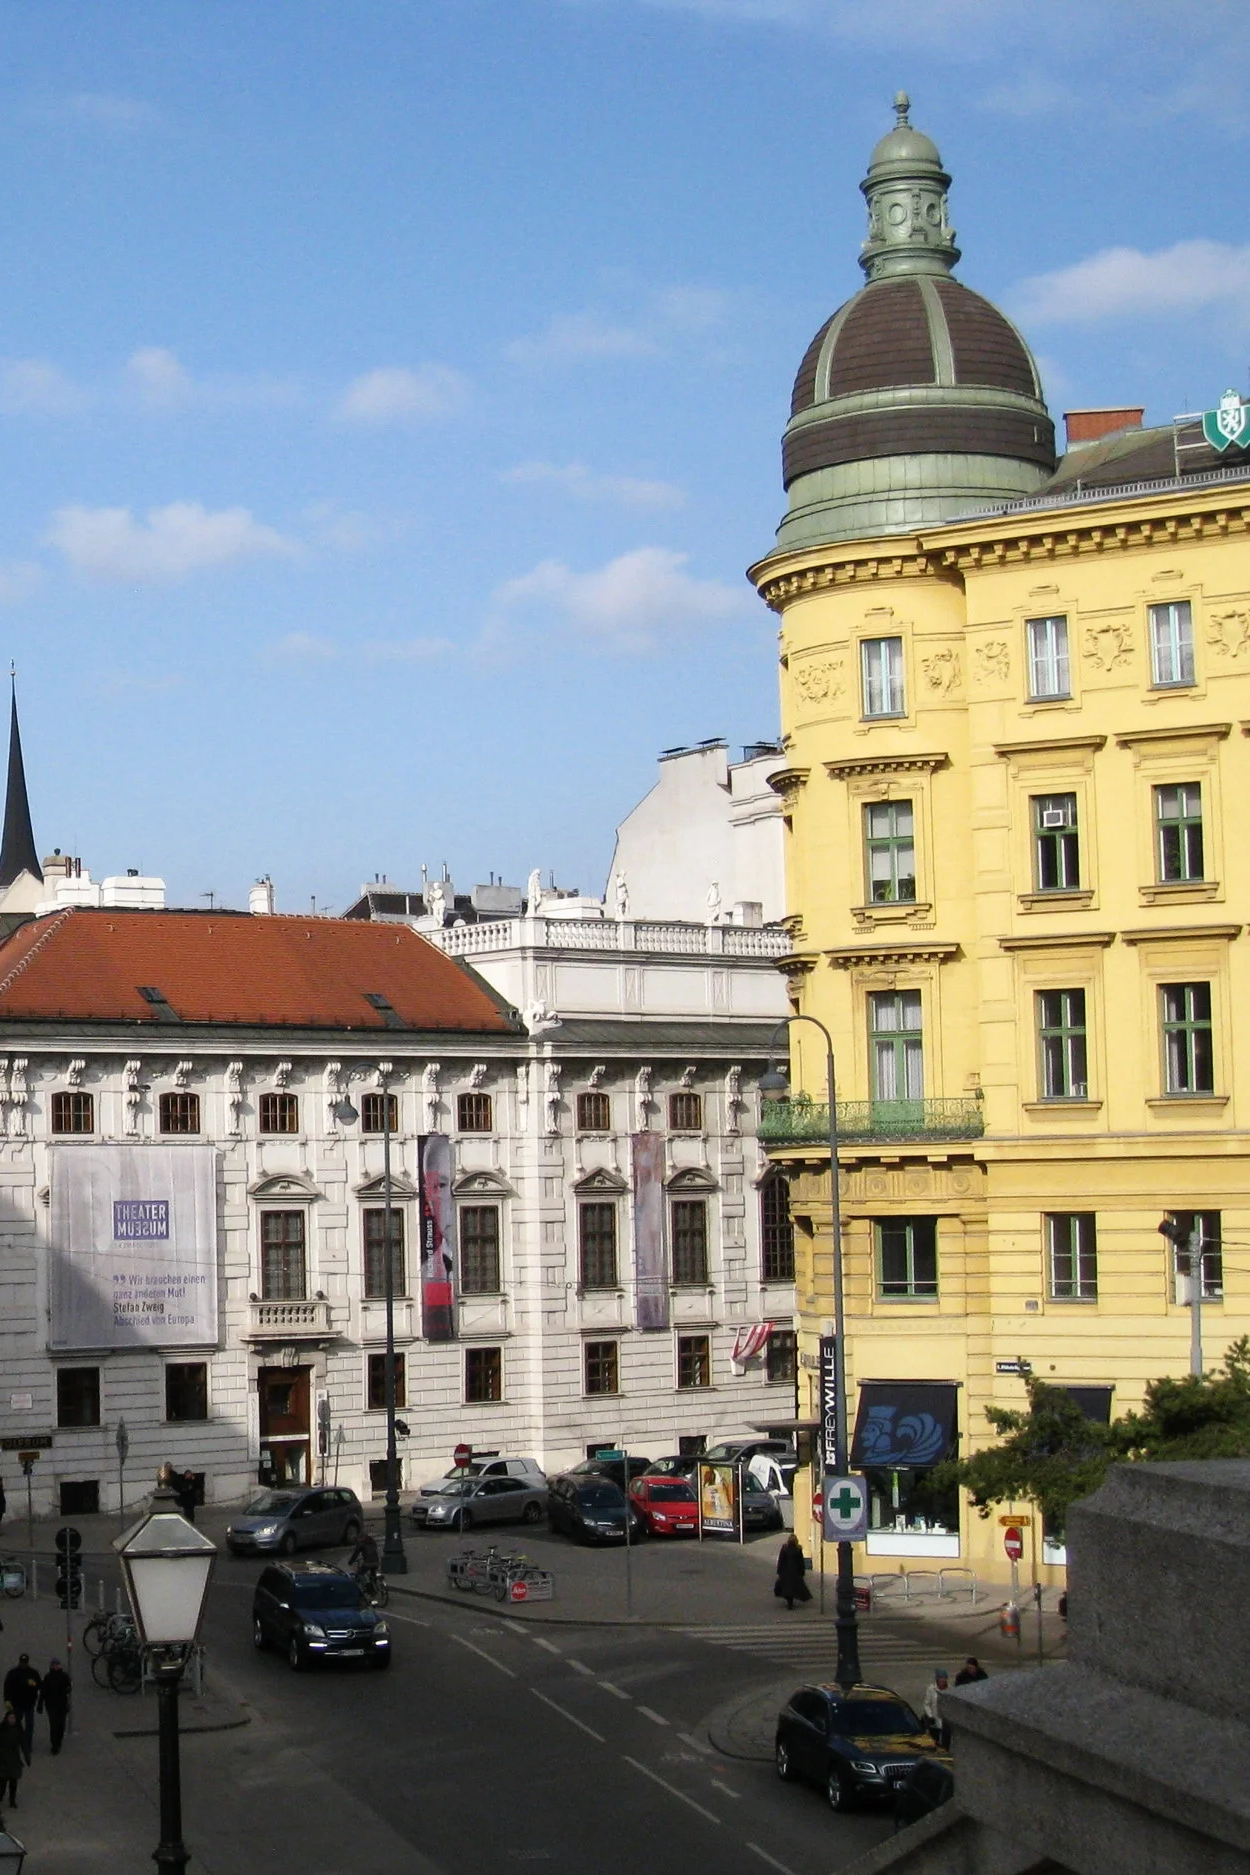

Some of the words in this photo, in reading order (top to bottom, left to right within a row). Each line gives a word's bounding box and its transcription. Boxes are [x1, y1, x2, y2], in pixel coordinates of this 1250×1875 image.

[115, 1204, 166, 1220] THEATER
[426, 1220, 434, 1248] Strauss
[113, 1302, 140, 1313] Stefan
[142, 1301, 164, 1313] Zweig
[167, 1314, 195, 1326] Europa
[824, 1347, 835, 1451] FREYWILLE
